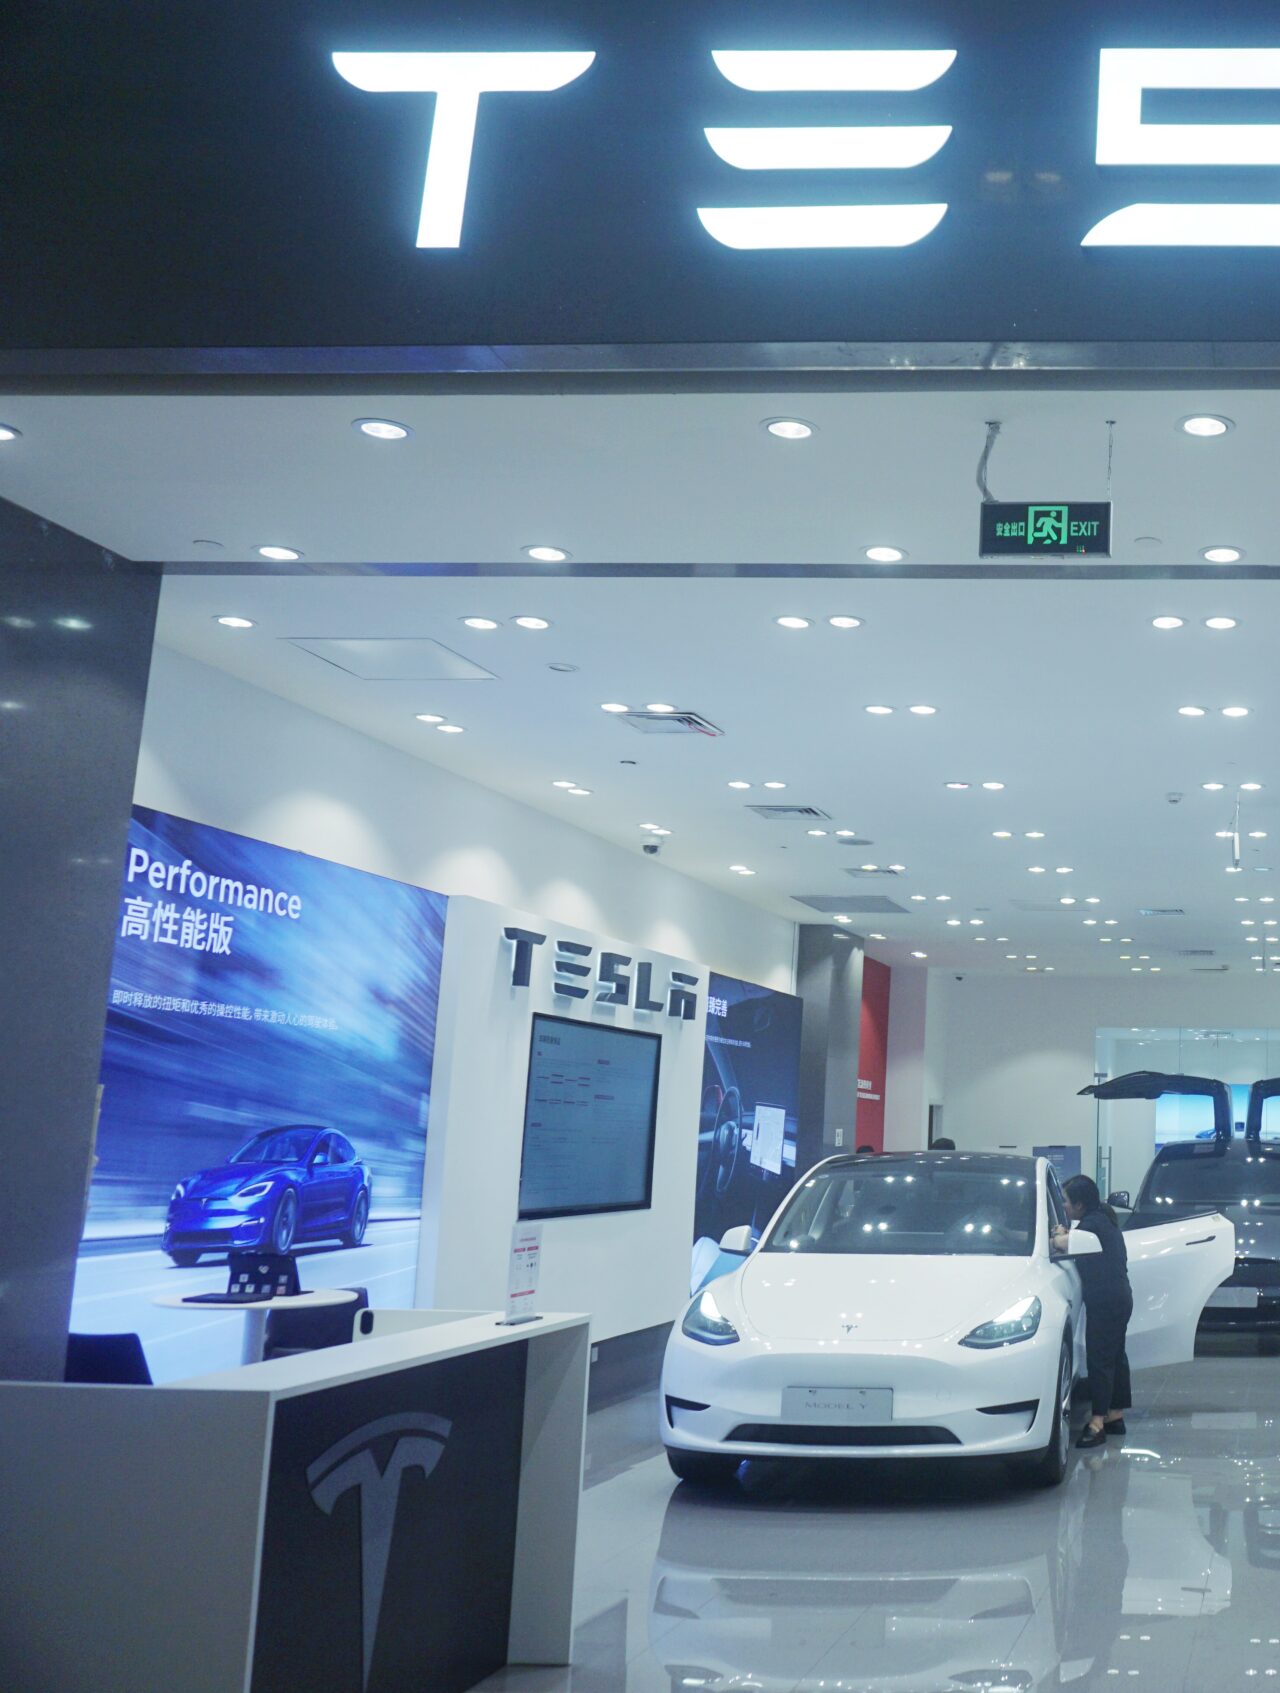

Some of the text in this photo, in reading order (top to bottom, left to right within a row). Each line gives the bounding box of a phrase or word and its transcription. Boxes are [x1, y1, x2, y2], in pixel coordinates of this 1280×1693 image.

[996, 521, 1026, 537] 安全出口
[1070, 521, 1100, 537] EXIT
[126, 847, 302, 919] Performance
[120, 896, 235, 956] 高性能版
[503, 927, 699, 1020] TESLA
